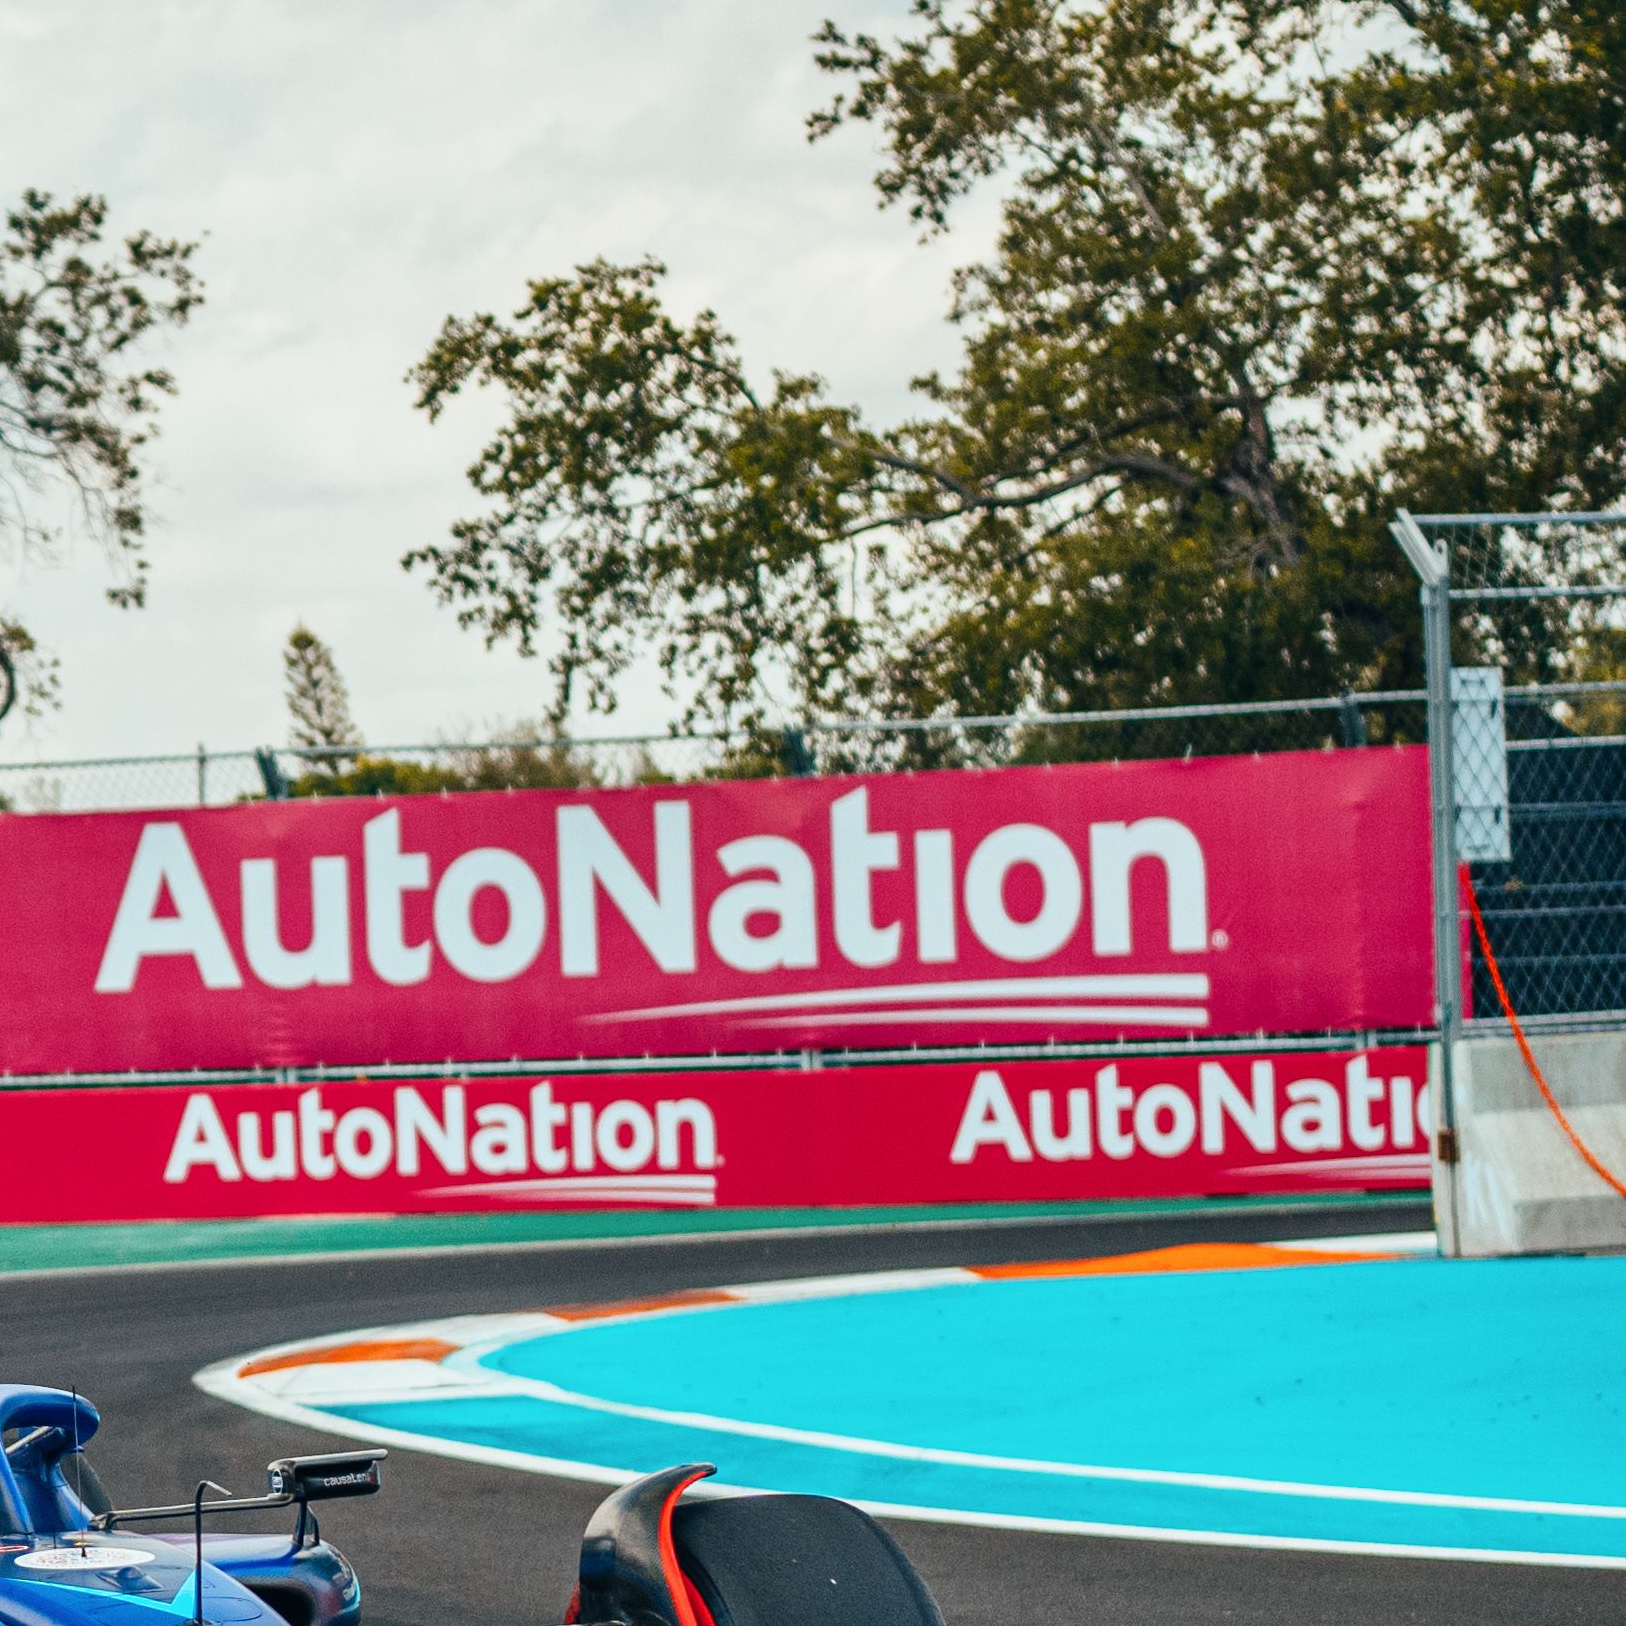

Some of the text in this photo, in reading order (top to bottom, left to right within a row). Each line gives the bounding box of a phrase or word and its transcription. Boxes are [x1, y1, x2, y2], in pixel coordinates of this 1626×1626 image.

[94, 787, 1208, 994] AutoNation
[164, 1081, 716, 1182] AutoNation
[949, 1055, 1430, 1163] AutoNati
